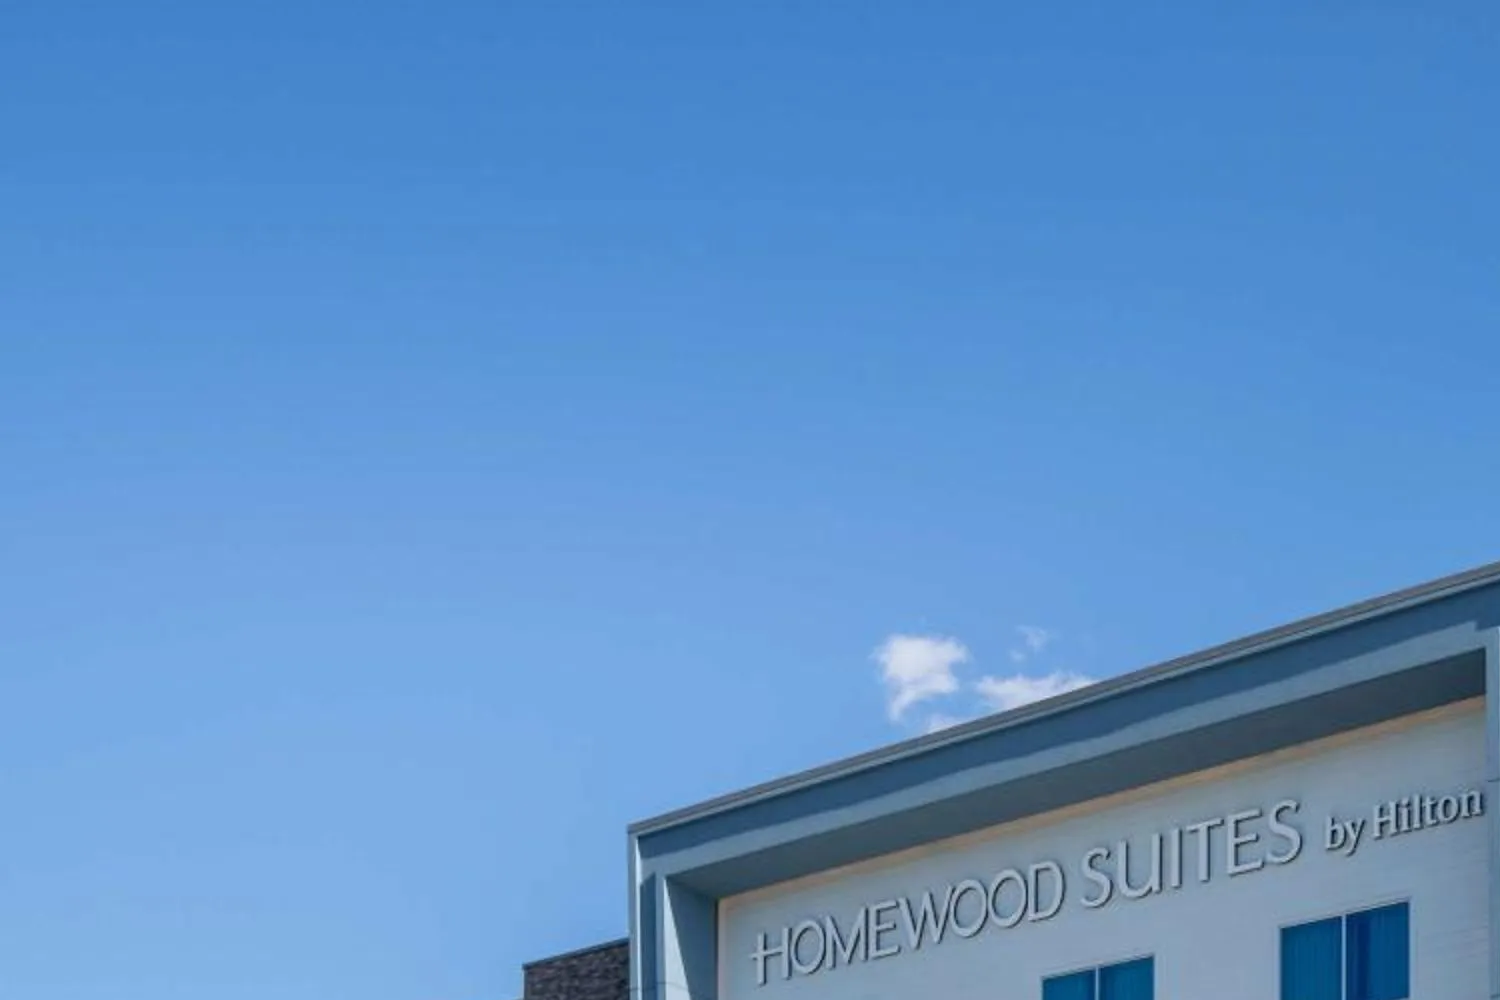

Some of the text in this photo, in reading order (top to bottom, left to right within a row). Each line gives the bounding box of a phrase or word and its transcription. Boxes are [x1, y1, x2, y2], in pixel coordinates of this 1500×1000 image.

[752, 787, 1485, 985] HOMEWOOD SUITES by Hilton
